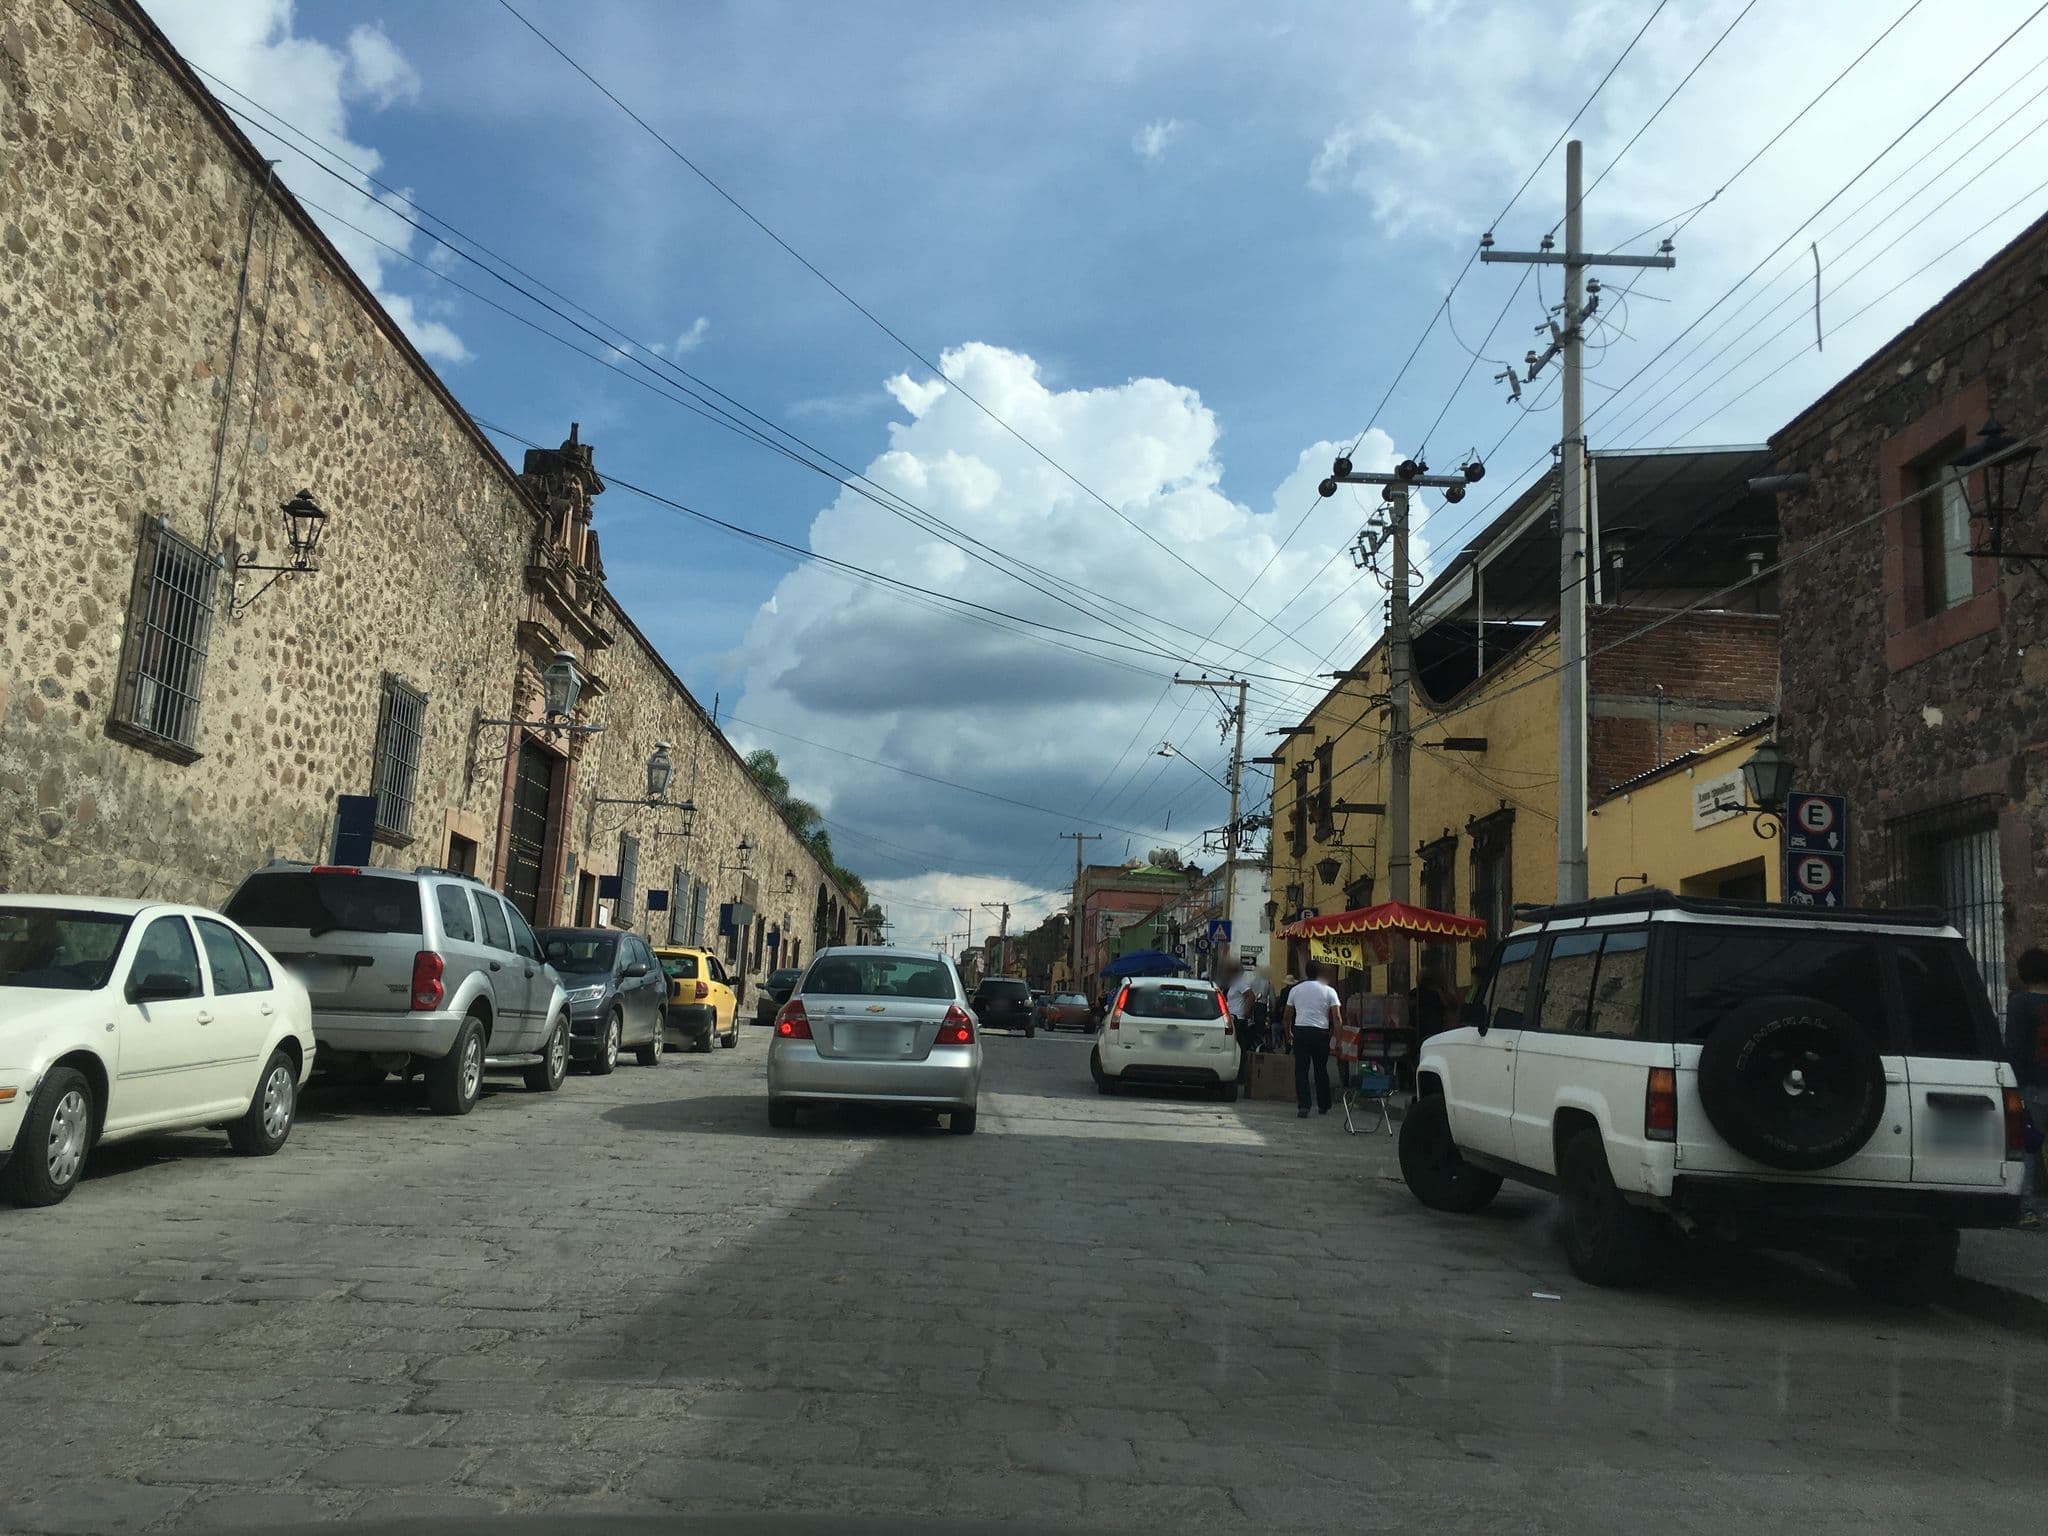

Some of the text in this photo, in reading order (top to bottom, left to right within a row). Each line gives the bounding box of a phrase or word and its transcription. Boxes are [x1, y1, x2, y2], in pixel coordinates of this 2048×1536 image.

[1807, 804, 1824, 825] E
[1807, 863, 1823, 884] E
[1322, 943, 1352, 959] $10
[1312, 954, 1362, 969] MEDIO LITRO
